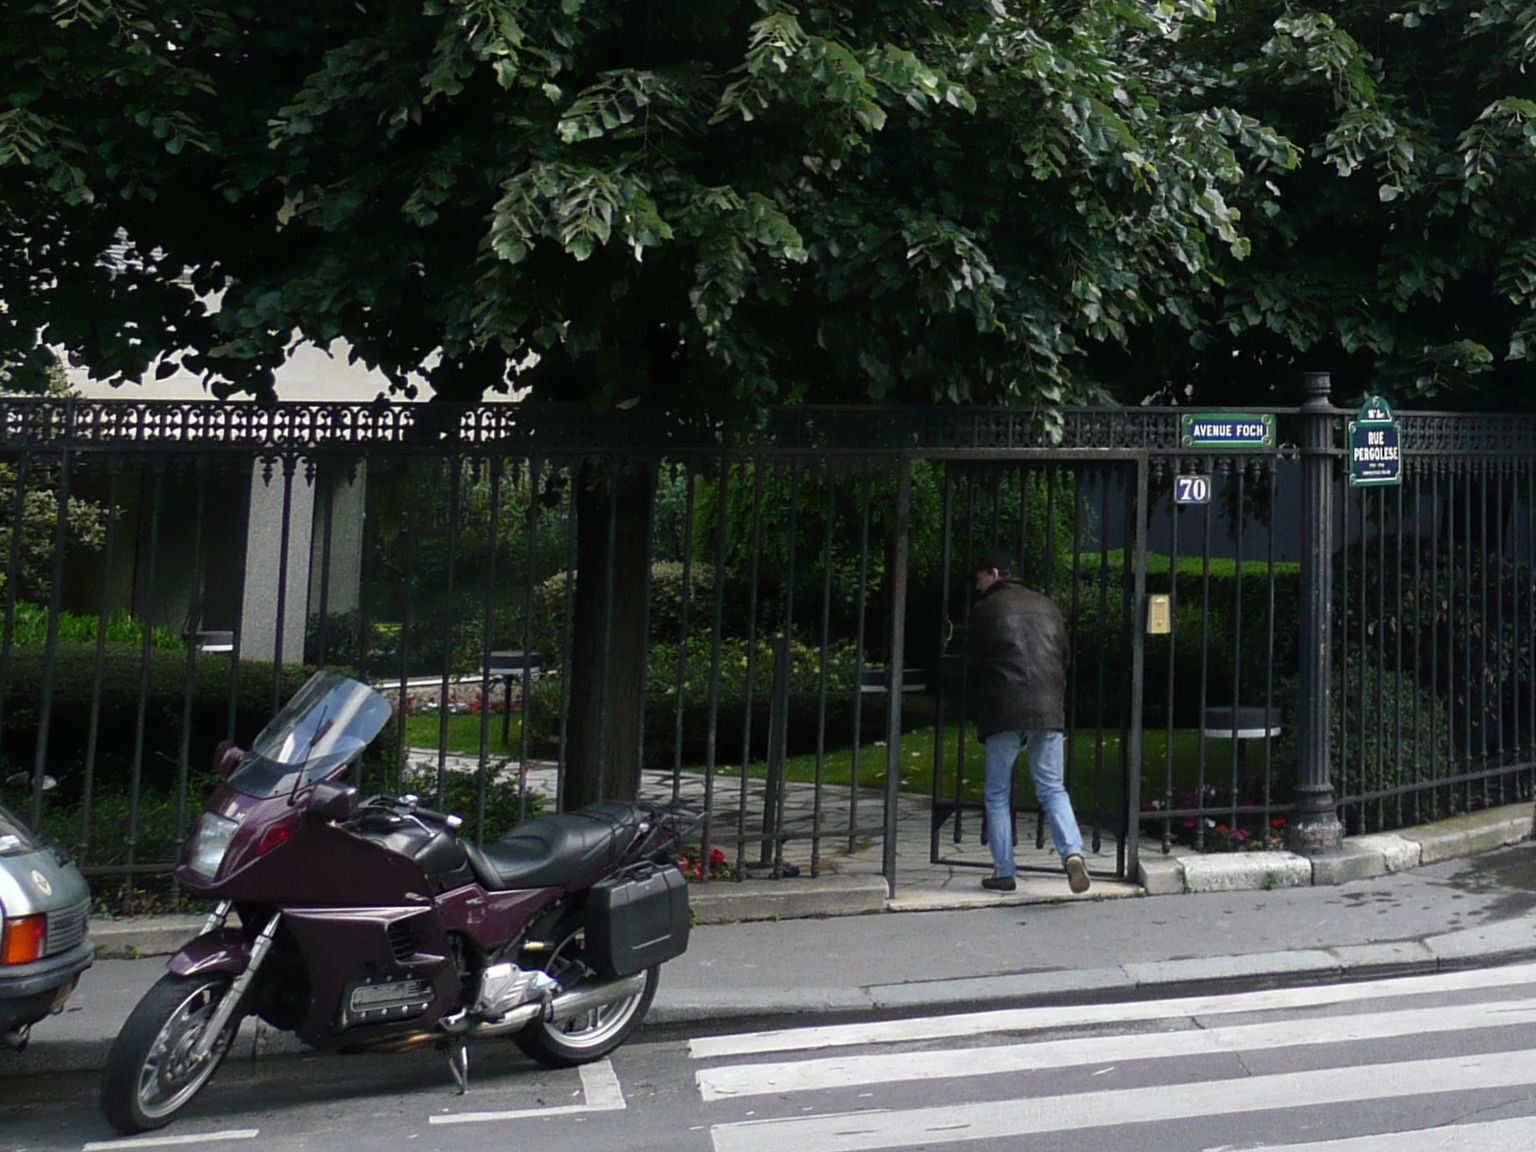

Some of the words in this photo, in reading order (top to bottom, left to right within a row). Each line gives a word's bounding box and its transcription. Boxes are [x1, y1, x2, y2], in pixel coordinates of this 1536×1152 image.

[1193, 424, 1232, 437] AVENUE
[1236, 424, 1263, 437] FOCH
[1368, 431, 1385, 445] RUE
[1353, 447, 1399, 461] PERGOLESE
[1180, 478, 1206, 500] 70
